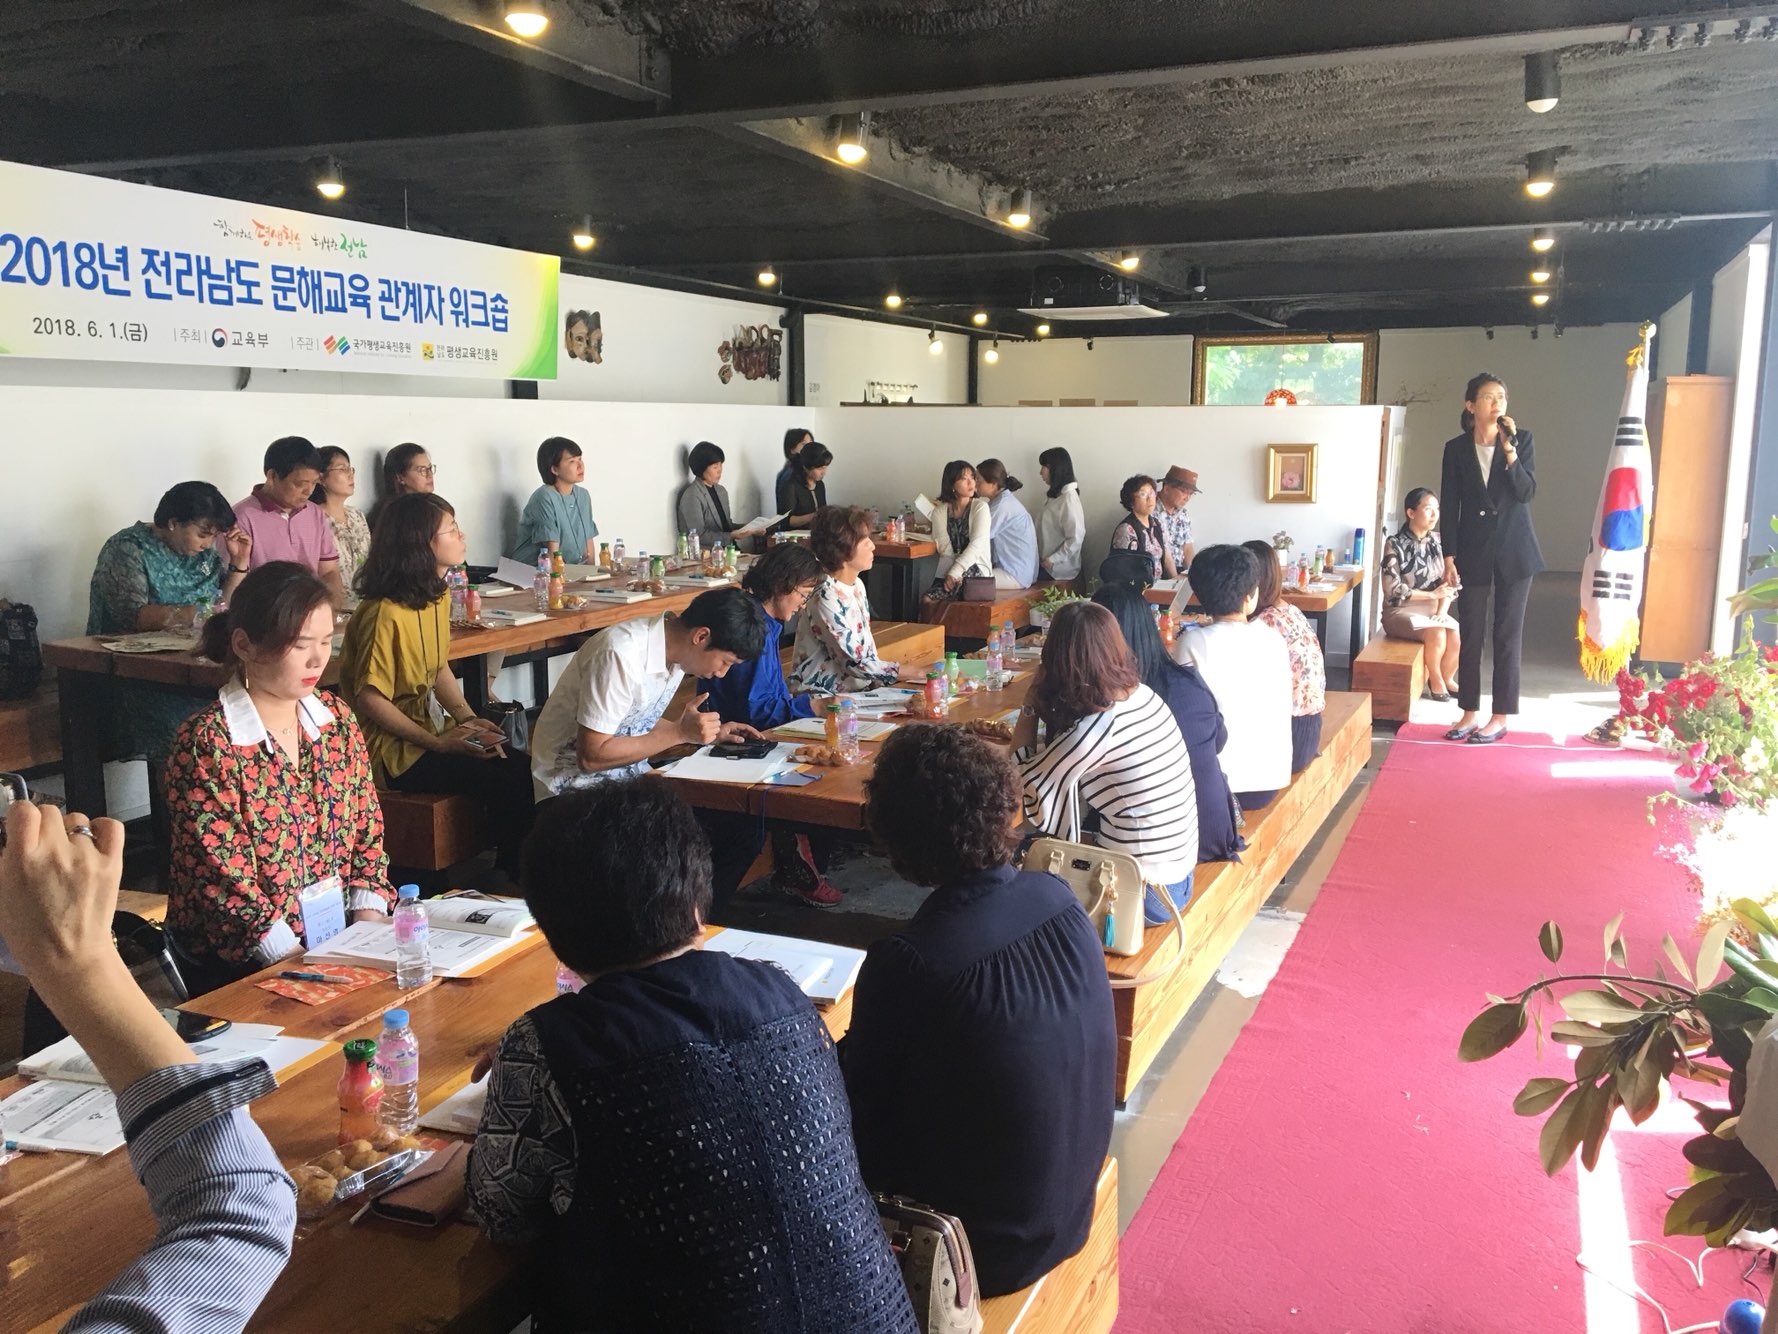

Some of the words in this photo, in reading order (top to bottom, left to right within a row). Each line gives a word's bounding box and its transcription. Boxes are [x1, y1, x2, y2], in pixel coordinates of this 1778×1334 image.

[340, 233, 367, 258] 전남
[0, 233, 131, 297] 2018년
[141, 247, 263, 306] 전라남도
[271, 264, 371, 319] 문해교육
[378, 278, 445, 326] 관계자
[449, 286, 509, 333] 워크숍
[33, 317, 81, 337] 2018.
[87, 320, 103, 338] 6.
[109, 321, 148, 342] 1.(금)
[180, 328, 200, 344] 주최
[231, 331, 269, 348] 교육부
[296, 336, 314, 351] 주관
[353, 338, 411, 354] 국가평생교육진흥원
[446, 345, 498, 361] 평생교육진흥원
